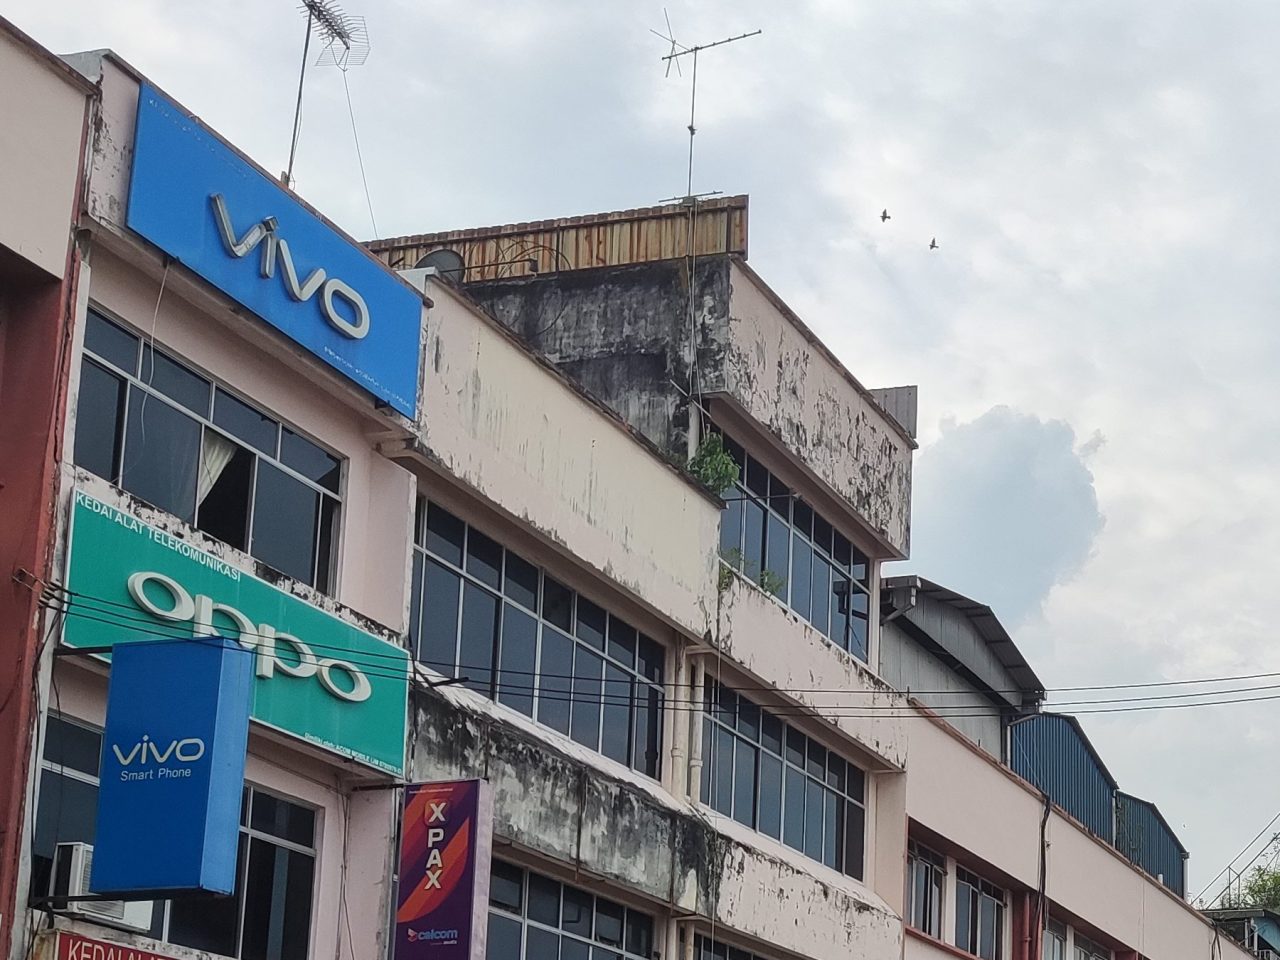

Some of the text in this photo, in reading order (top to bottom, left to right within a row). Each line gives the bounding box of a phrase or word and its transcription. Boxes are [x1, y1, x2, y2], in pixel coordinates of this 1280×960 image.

[210, 193, 371, 340] vivo
[76, 491, 241, 582] KEDAI ALAT TELEKOMUNIKASI
[128, 571, 372, 702] oppo
[113, 735, 205, 766] vivo
[120, 767, 192, 782] Smart Phone
